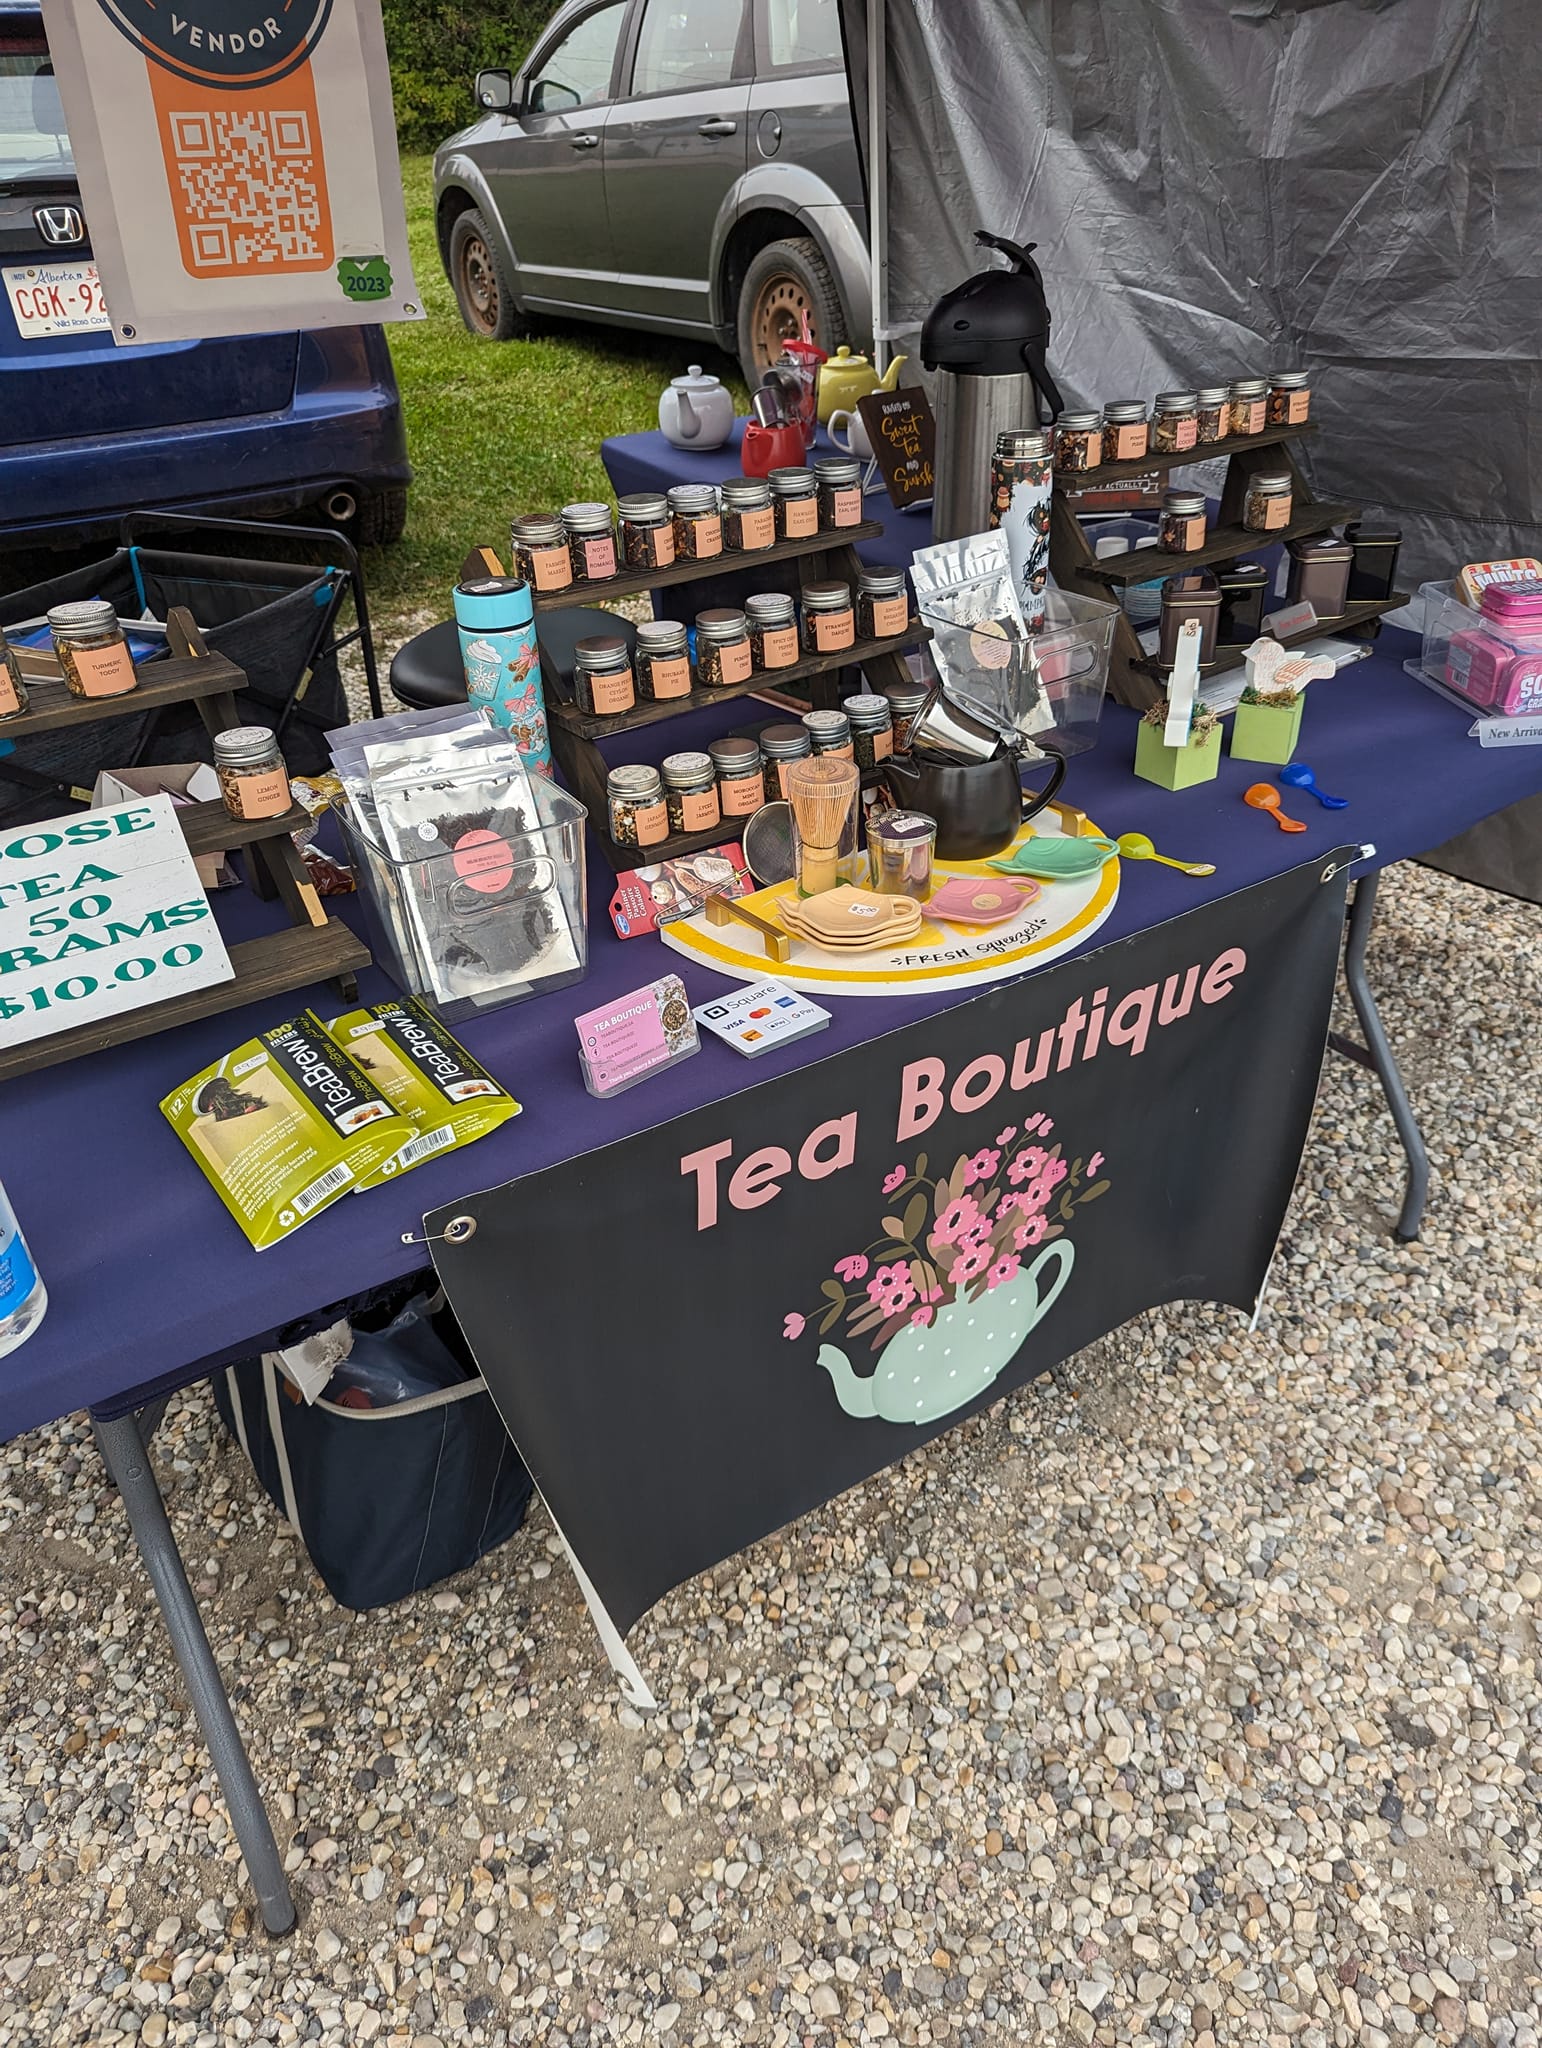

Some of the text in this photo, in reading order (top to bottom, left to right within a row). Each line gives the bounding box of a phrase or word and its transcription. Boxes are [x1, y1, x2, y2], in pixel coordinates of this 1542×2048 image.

[170, 13, 282, 54] VENDOR
[346, 275, 386, 293] 2023
[53, 319, 70, 328] Wild
[882, 402, 902, 415] RAISED
[882, 415, 924, 441] Sweet
[591, 546, 608, 554] NOTES
[590, 560, 614, 568] ROMANCE
[1473, 569, 1537, 590] MINTS
[92, 658, 122, 671] TURMERIC
[100, 667, 120, 678] TODDY
[662, 670, 686, 678] RHUBARB
[599, 682, 620, 690] ORANGE
[1488, 727, 1511, 738] New
[256, 784, 278, 794] LEMON
[258, 792, 281, 804] GINGER
[734, 784, 760, 794] MOROCCAN
[0, 808, 156, 860] OSE
[620, 888, 633, 920] Strainer
[626, 887, 641, 918] Passoire
[633, 886, 648, 917] Colador
[29, 894, 113, 937] 50
[906, 948, 969, 966] FRESH
[0, 944, 204, 1019] $10.00
[726, 986, 777, 1010] Square
[371, 1002, 400, 1014] 100
[378, 1010, 406, 1020] FILTERS
[594, 1000, 652, 1032] TEA BOUTIQUE
[263, 1022, 294, 1042] 100
[723, 1019, 746, 1031] VISA
[270, 1030, 300, 1048] FILTERS
[391, 1018, 465, 1085] TeaBrew
[283, 1038, 356, 1118] TeaBrew
[680, 948, 1246, 1231] Tea Boutique
[259, 1149, 285, 1173] unbleached
[284, 1140, 299, 1152] paper
[288, 1146, 312, 1166] harvested
[244, 1160, 261, 1177] Canada
[248, 1164, 278, 1194] biodegradable
